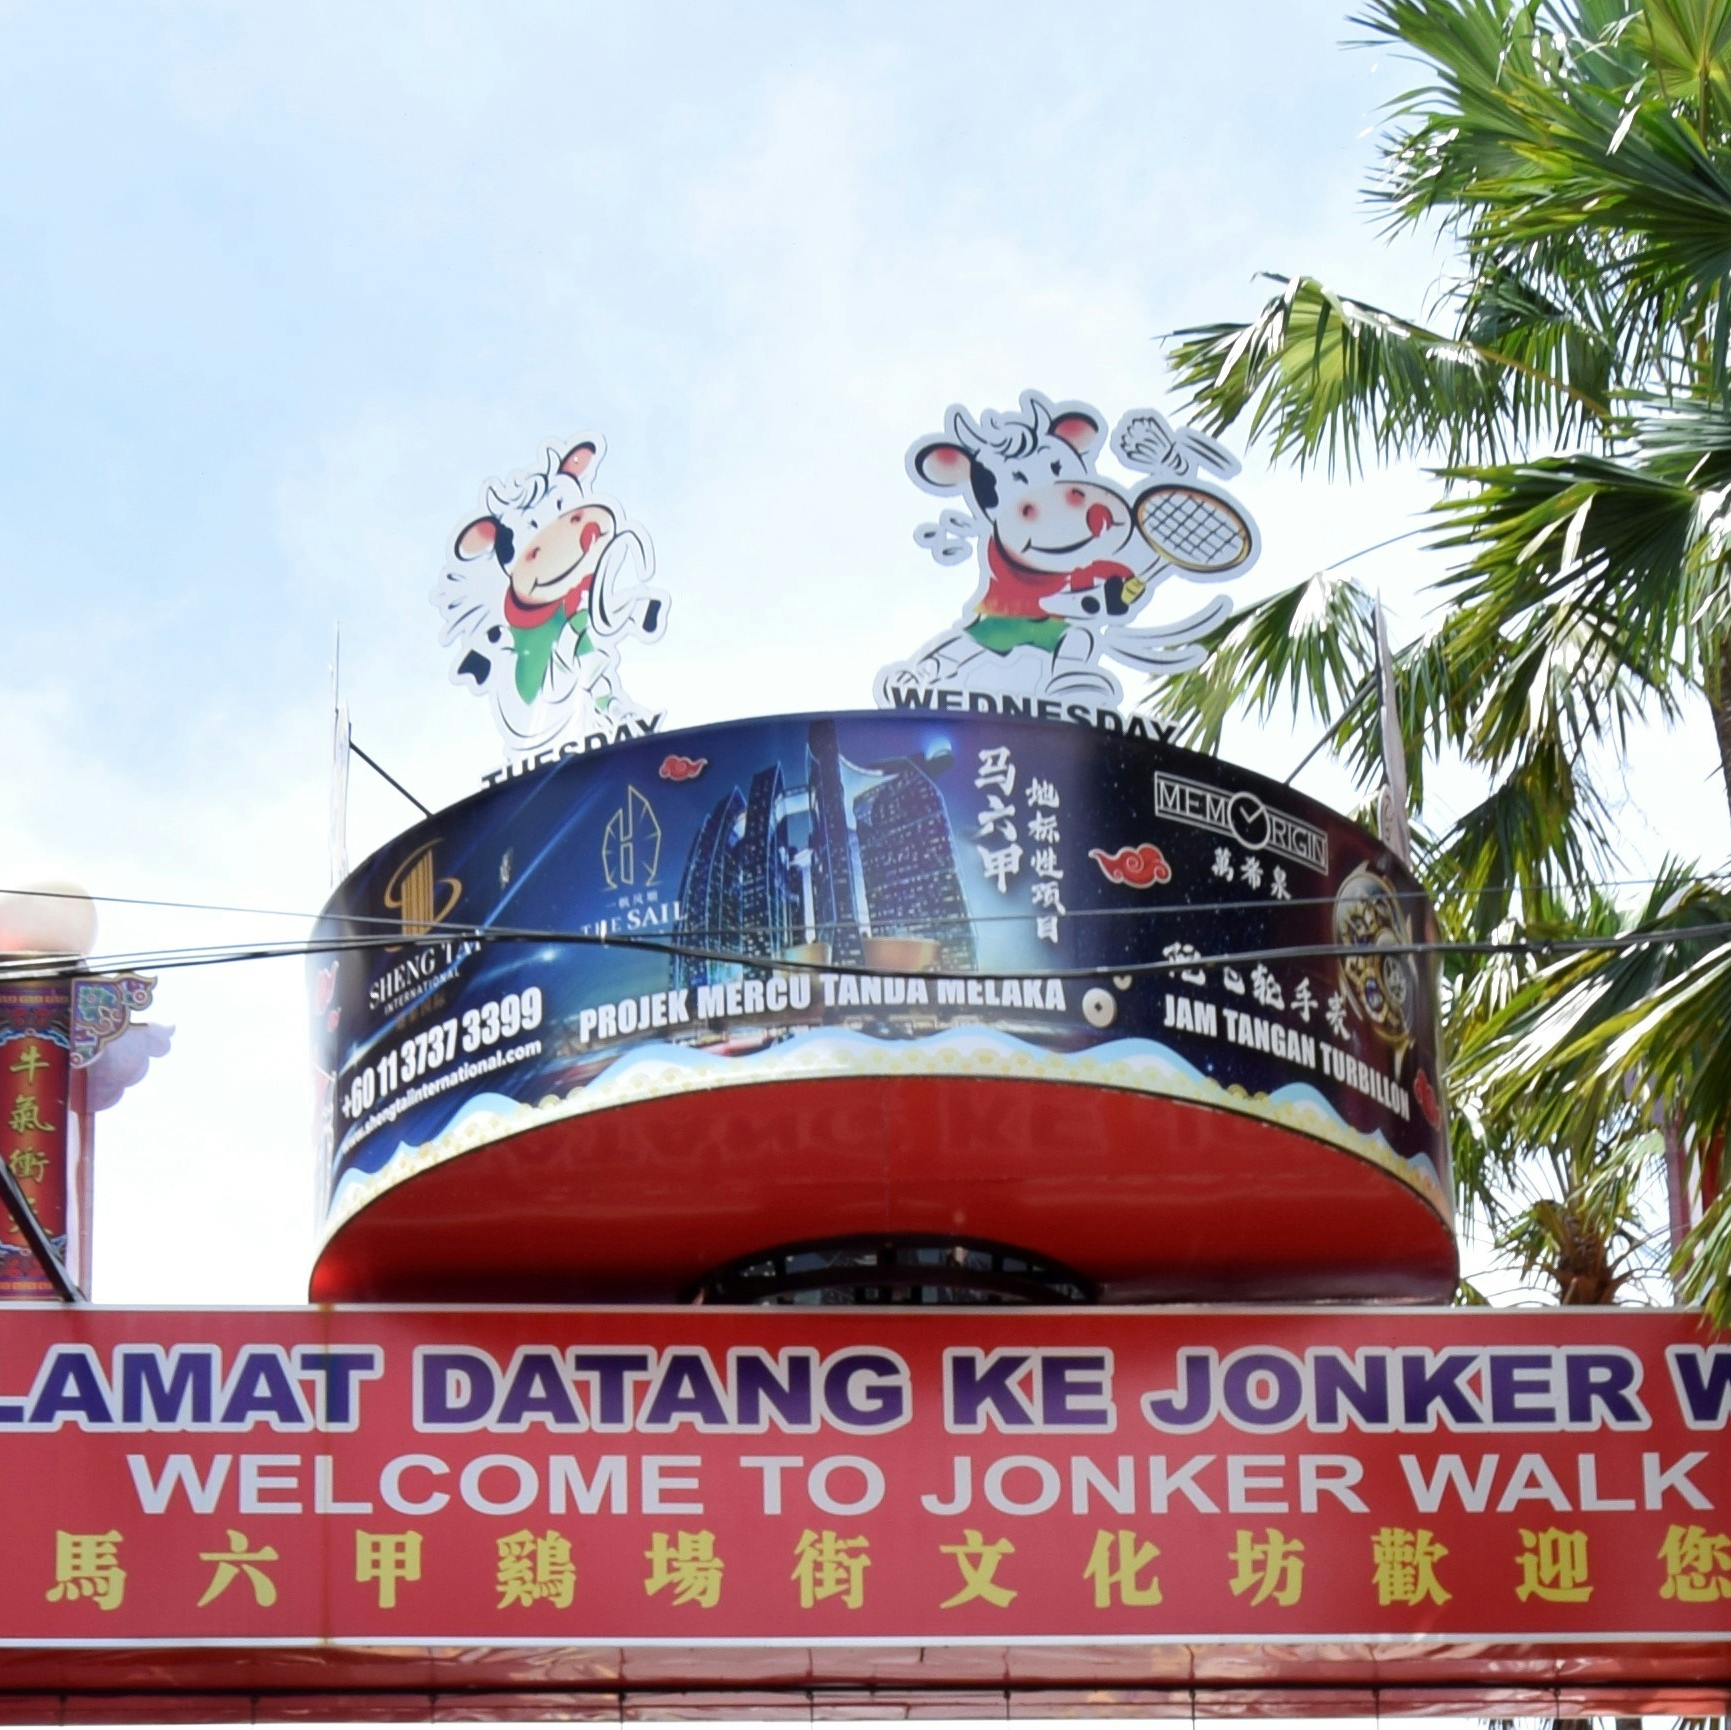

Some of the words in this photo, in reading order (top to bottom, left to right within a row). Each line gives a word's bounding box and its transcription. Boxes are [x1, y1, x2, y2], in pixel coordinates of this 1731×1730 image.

[975, 745, 1023, 893] 马六甲
[1026, 777, 1066, 944] 地标性项目
[1211, 846, 1292, 901] 萬希泉
[627, 901, 689, 931] SAIL
[369, 948, 436, 1011] SHENG
[383, 967, 460, 1016] INTERNATIONAL
[580, 988, 688, 1044] PROJEK
[697, 974, 811, 1018] MERCU
[937, 976, 1067, 1011] MELAKA
[341, 1067, 375, 1119] +60
[377, 1050, 398, 1097] 11
[401, 1017, 458, 1083] 3737
[462, 986, 543, 1053] 3399
[1163, 994, 1217, 1038] JAM
[1222, 1007, 1316, 1069] TANGAN
[417, 1347, 908, 1431] DATANG
[947, 1347, 1115, 1431] KE
[1145, 1346, 1649, 1431] JONKER
[126, 1453, 704, 1516] WELCOME
[740, 1453, 886, 1516] TO
[920, 1453, 1365, 1516] JONKER
[1398, 1450, 1716, 1512] WALK
